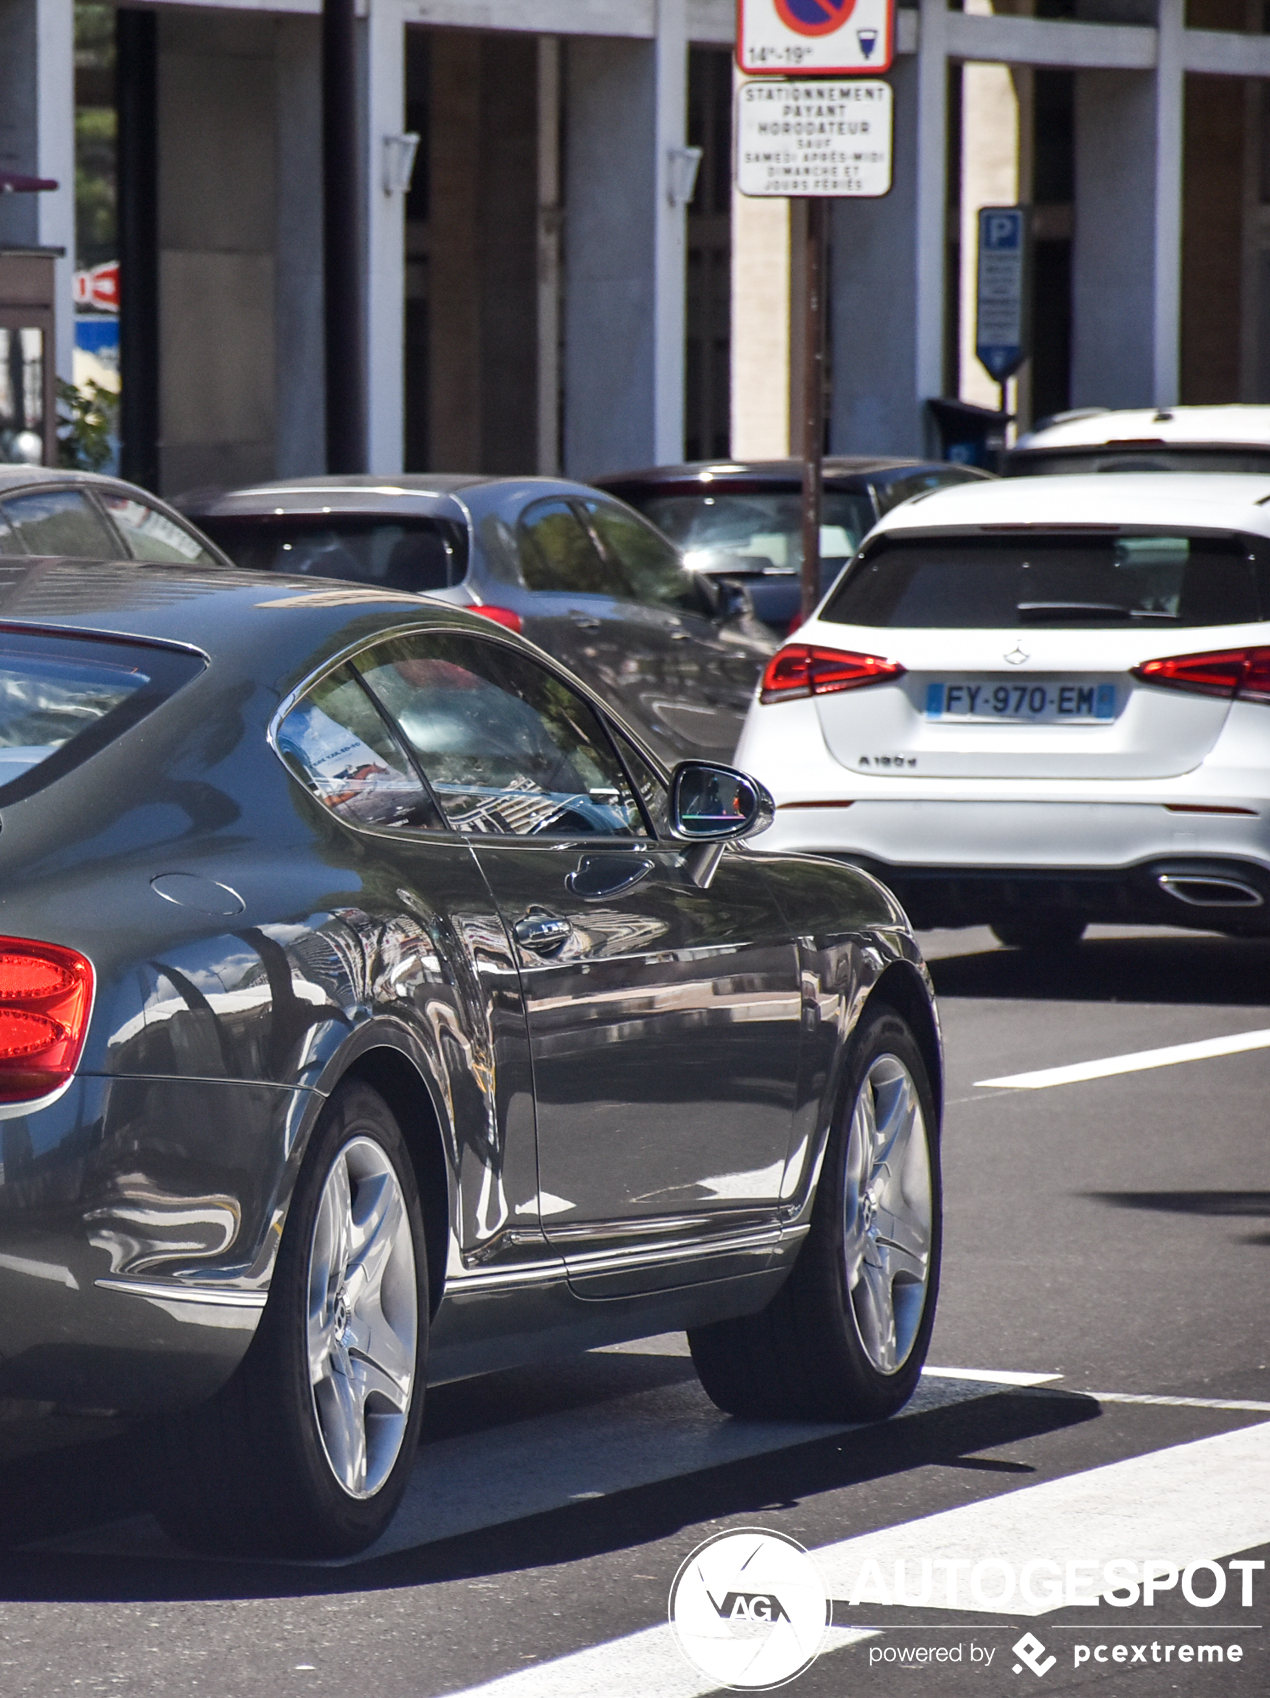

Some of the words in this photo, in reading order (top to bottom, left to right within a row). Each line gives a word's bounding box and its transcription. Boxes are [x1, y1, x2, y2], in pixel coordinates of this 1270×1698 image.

[746, 88, 885, 102] STATIONNEMENT
[783, 105, 846, 118] PAYANT
[758, 121, 870, 135] HORODATEUR
[797, 138, 832, 150] SAUF
[744, 152, 798, 164] SAMEDI
[768, 165, 840, 177] DIMANCHE
[844, 165, 861, 177] ET
[764, 180, 809, 191] JOURS
[989, 218, 1014, 247] P
[946, 685, 1096, 714] FY-970-EM
